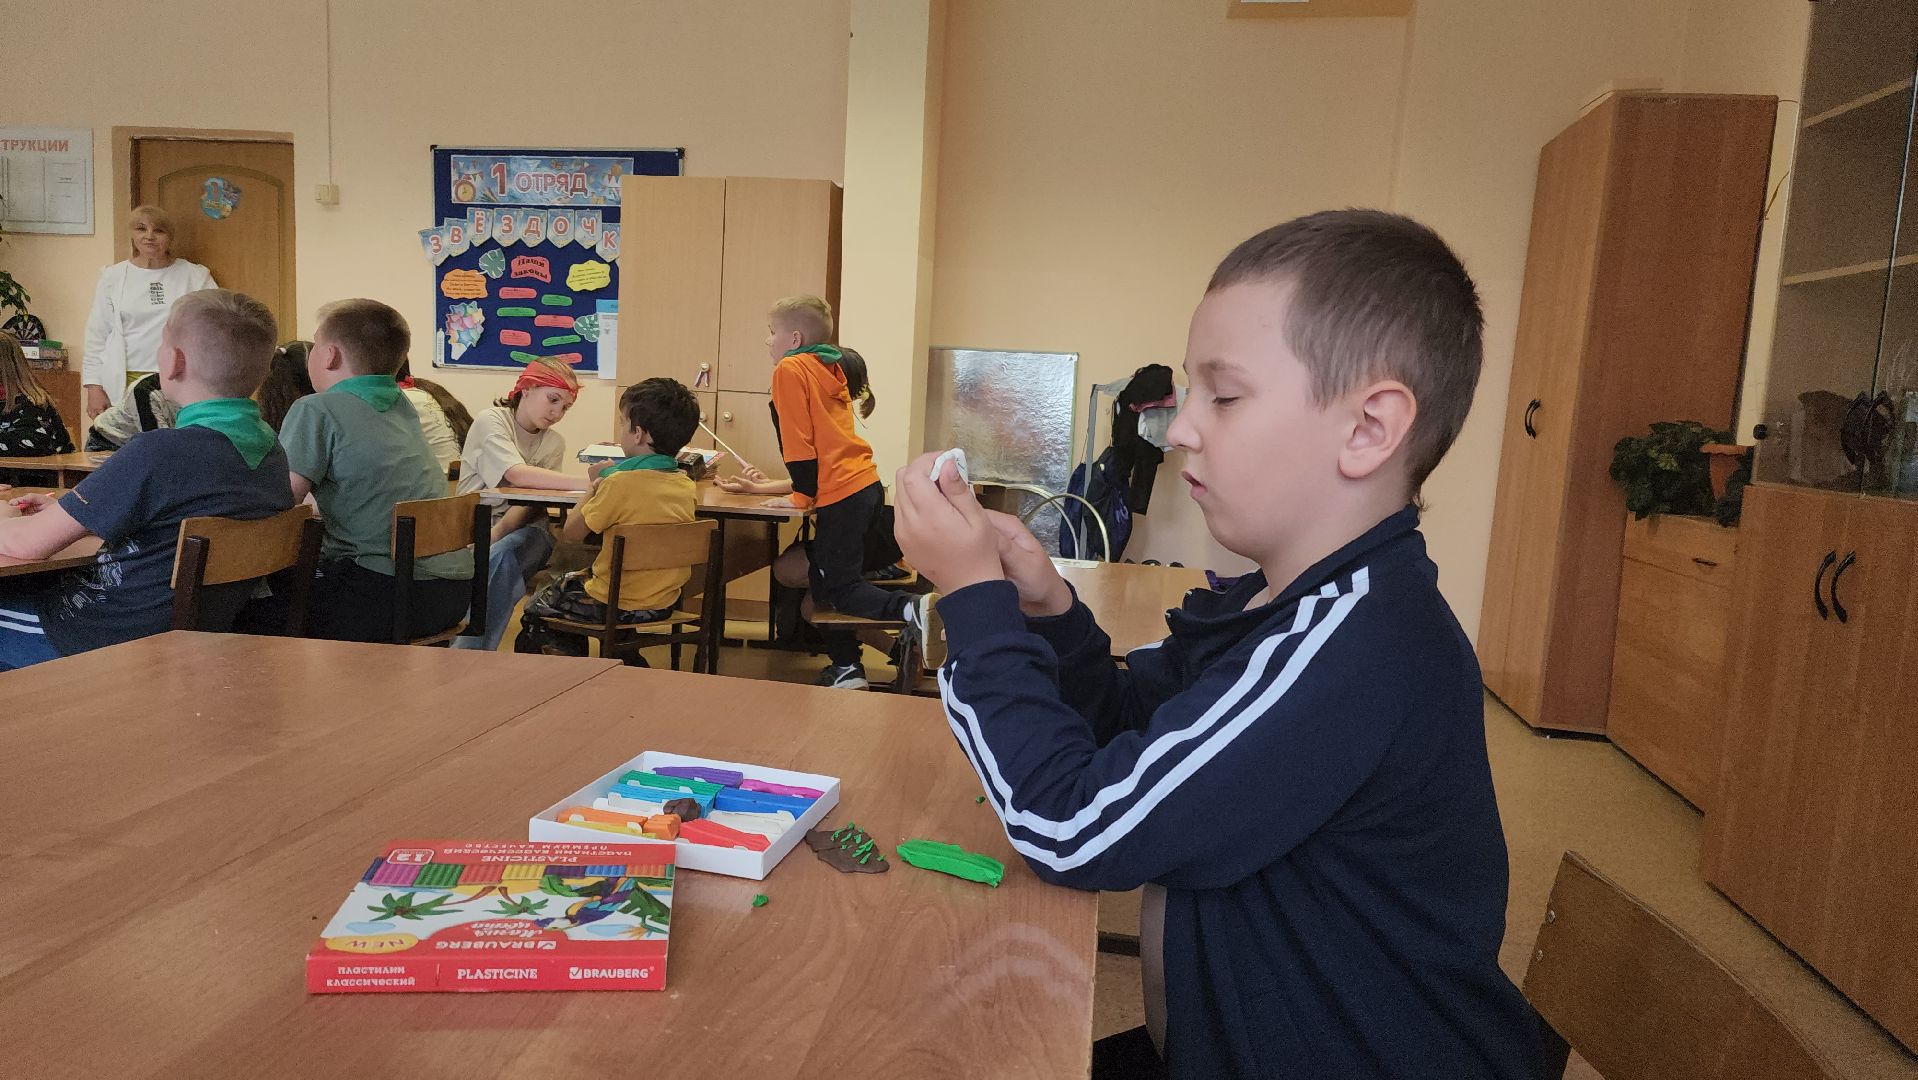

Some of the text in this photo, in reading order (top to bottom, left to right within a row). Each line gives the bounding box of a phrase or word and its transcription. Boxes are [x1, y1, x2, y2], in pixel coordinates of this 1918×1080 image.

[0, 139, 69, 153] ТРУКЦИИ
[491, 162, 589, 198] 1 ОТРЯД
[429, 211, 617, 254] ЗВЁЗДОЧК
[396, 852, 425, 862] 12
[481, 855, 578, 863] PLASTICINE
[345, 939, 405, 949] NEW
[435, 940, 536, 950] BRAUBERG
[457, 968, 538, 980] PLASTICINE
[583, 968, 649, 979] BRAUBERG
